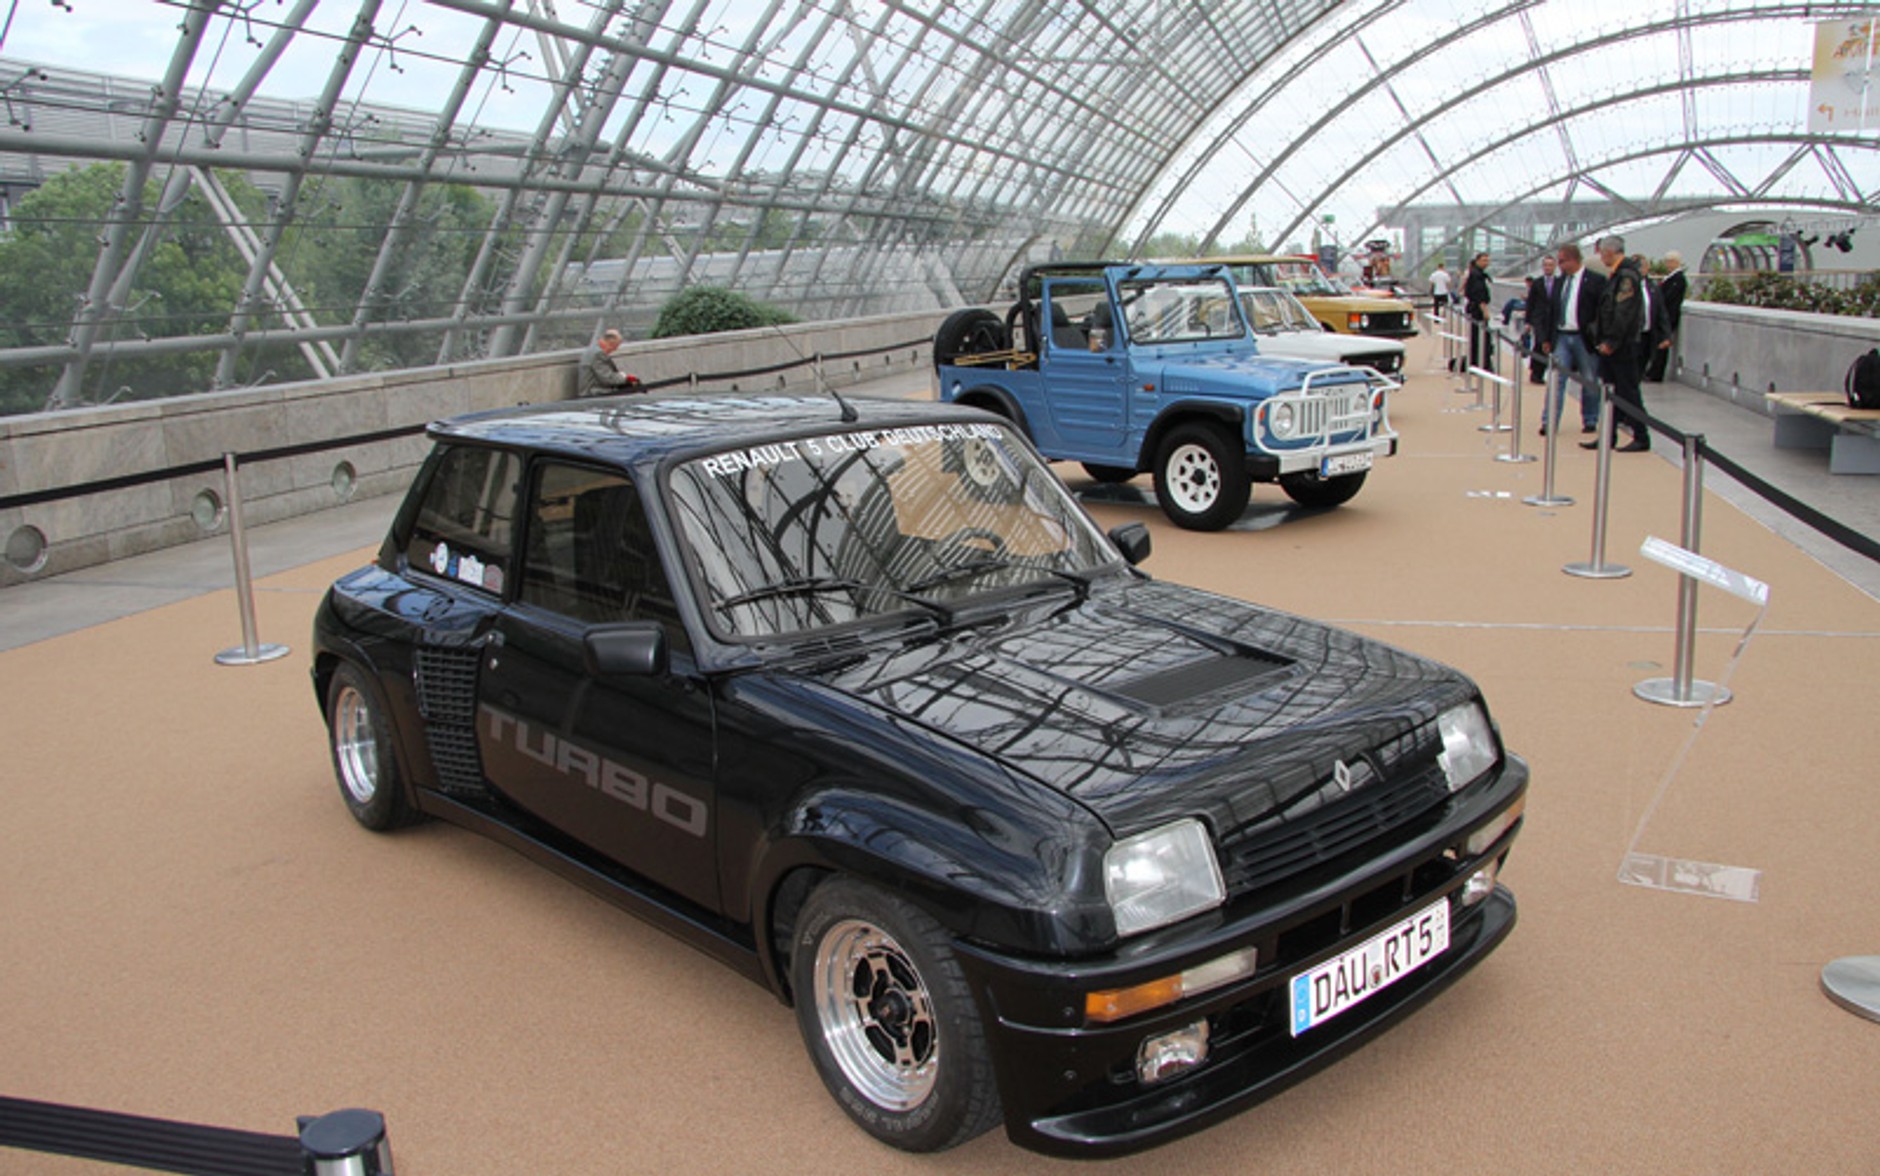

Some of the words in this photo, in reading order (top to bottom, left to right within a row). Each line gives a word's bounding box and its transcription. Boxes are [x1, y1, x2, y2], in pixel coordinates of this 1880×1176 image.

[702, 442, 800, 479] RENAULT
[811, 441, 822, 456] 5
[826, 432, 880, 454] CLUB
[882, 423, 1002, 446] DEUTSCHLAND
[480, 702, 708, 838] TURBO
